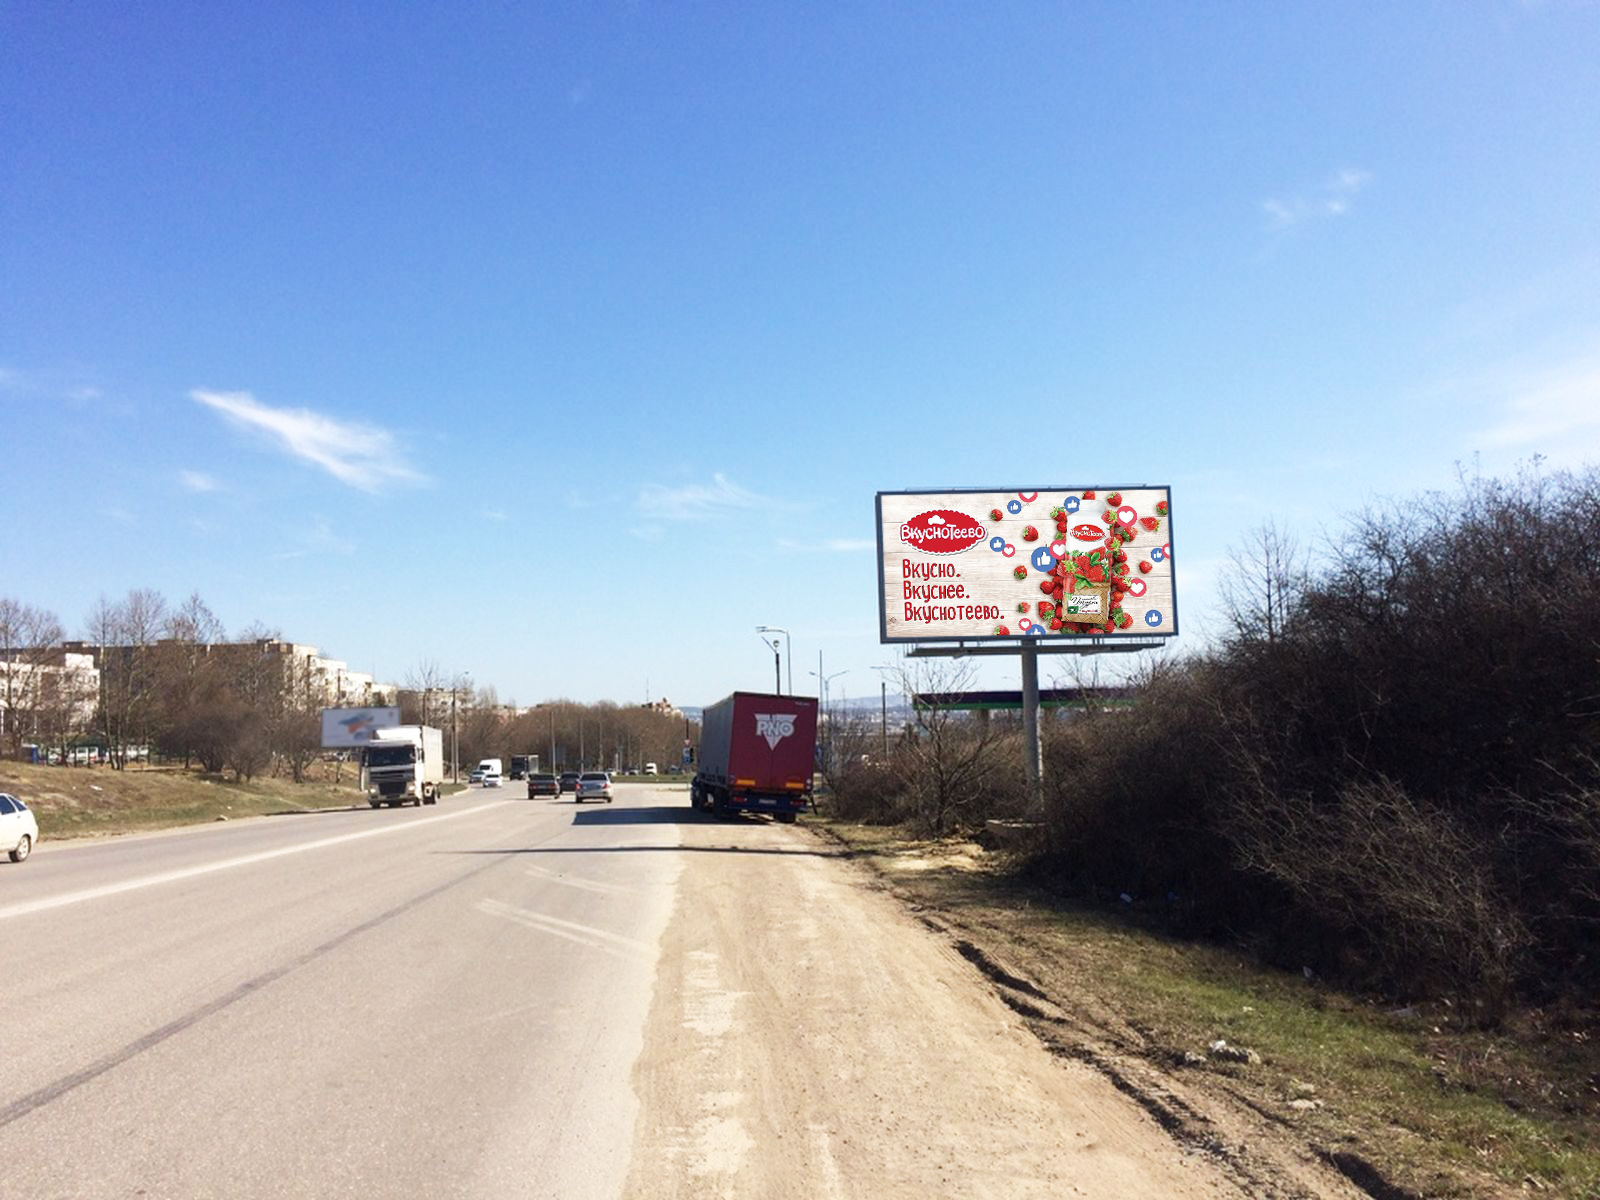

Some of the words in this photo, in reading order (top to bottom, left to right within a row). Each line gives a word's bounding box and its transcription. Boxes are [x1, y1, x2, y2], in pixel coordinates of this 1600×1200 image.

[901, 524, 985, 543] ВкусноТеево
[902, 558, 961, 581] Вкусно.
[903, 580, 970, 603] Вкуснее.
[904, 601, 1005, 624] Вкуснотеево.
